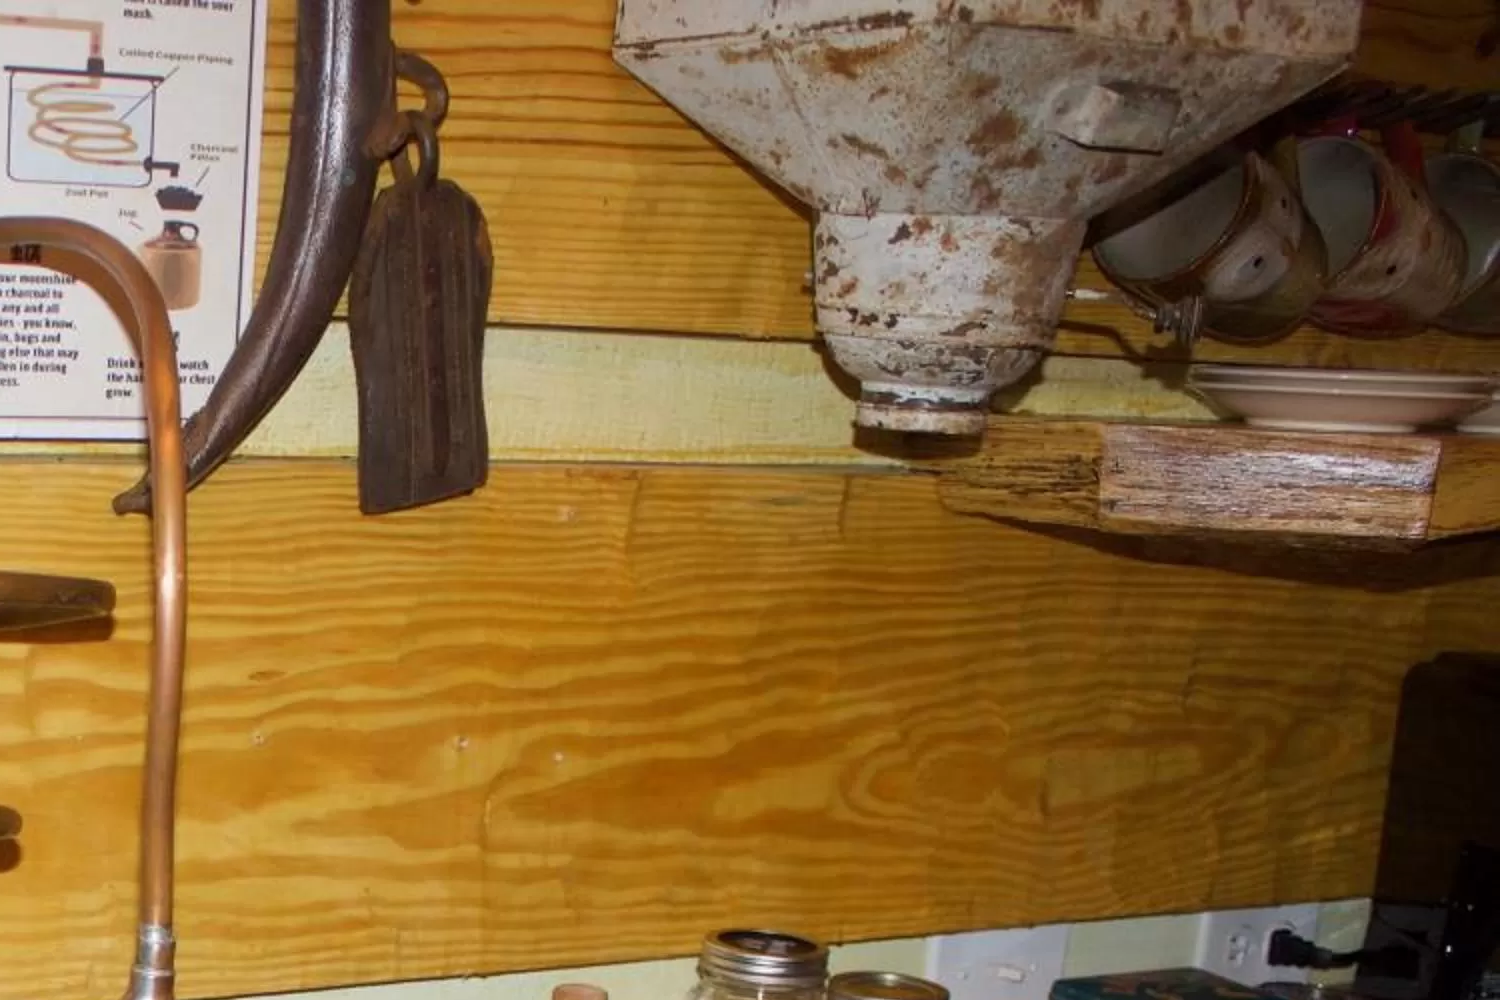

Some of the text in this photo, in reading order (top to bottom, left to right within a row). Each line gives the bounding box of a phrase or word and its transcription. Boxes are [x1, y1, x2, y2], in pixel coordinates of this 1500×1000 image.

[6, 288, 50, 298] charcoal
[53, 289, 63, 298] to
[2, 303, 21, 315] any
[24, 303, 42, 312] and
[46, 303, 59, 312] all
[23, 319, 42, 329] you
[42, 333, 61, 342] and
[9, 346, 30, 357] else
[34, 346, 54, 357] that
[58, 350, 78, 360] may
[20, 361, 29, 371] in
[32, 362, 66, 374] during
[107, 358, 135, 368] Drink
[180, 360, 209, 370] watch
[107, 373, 215, 384] the chest
